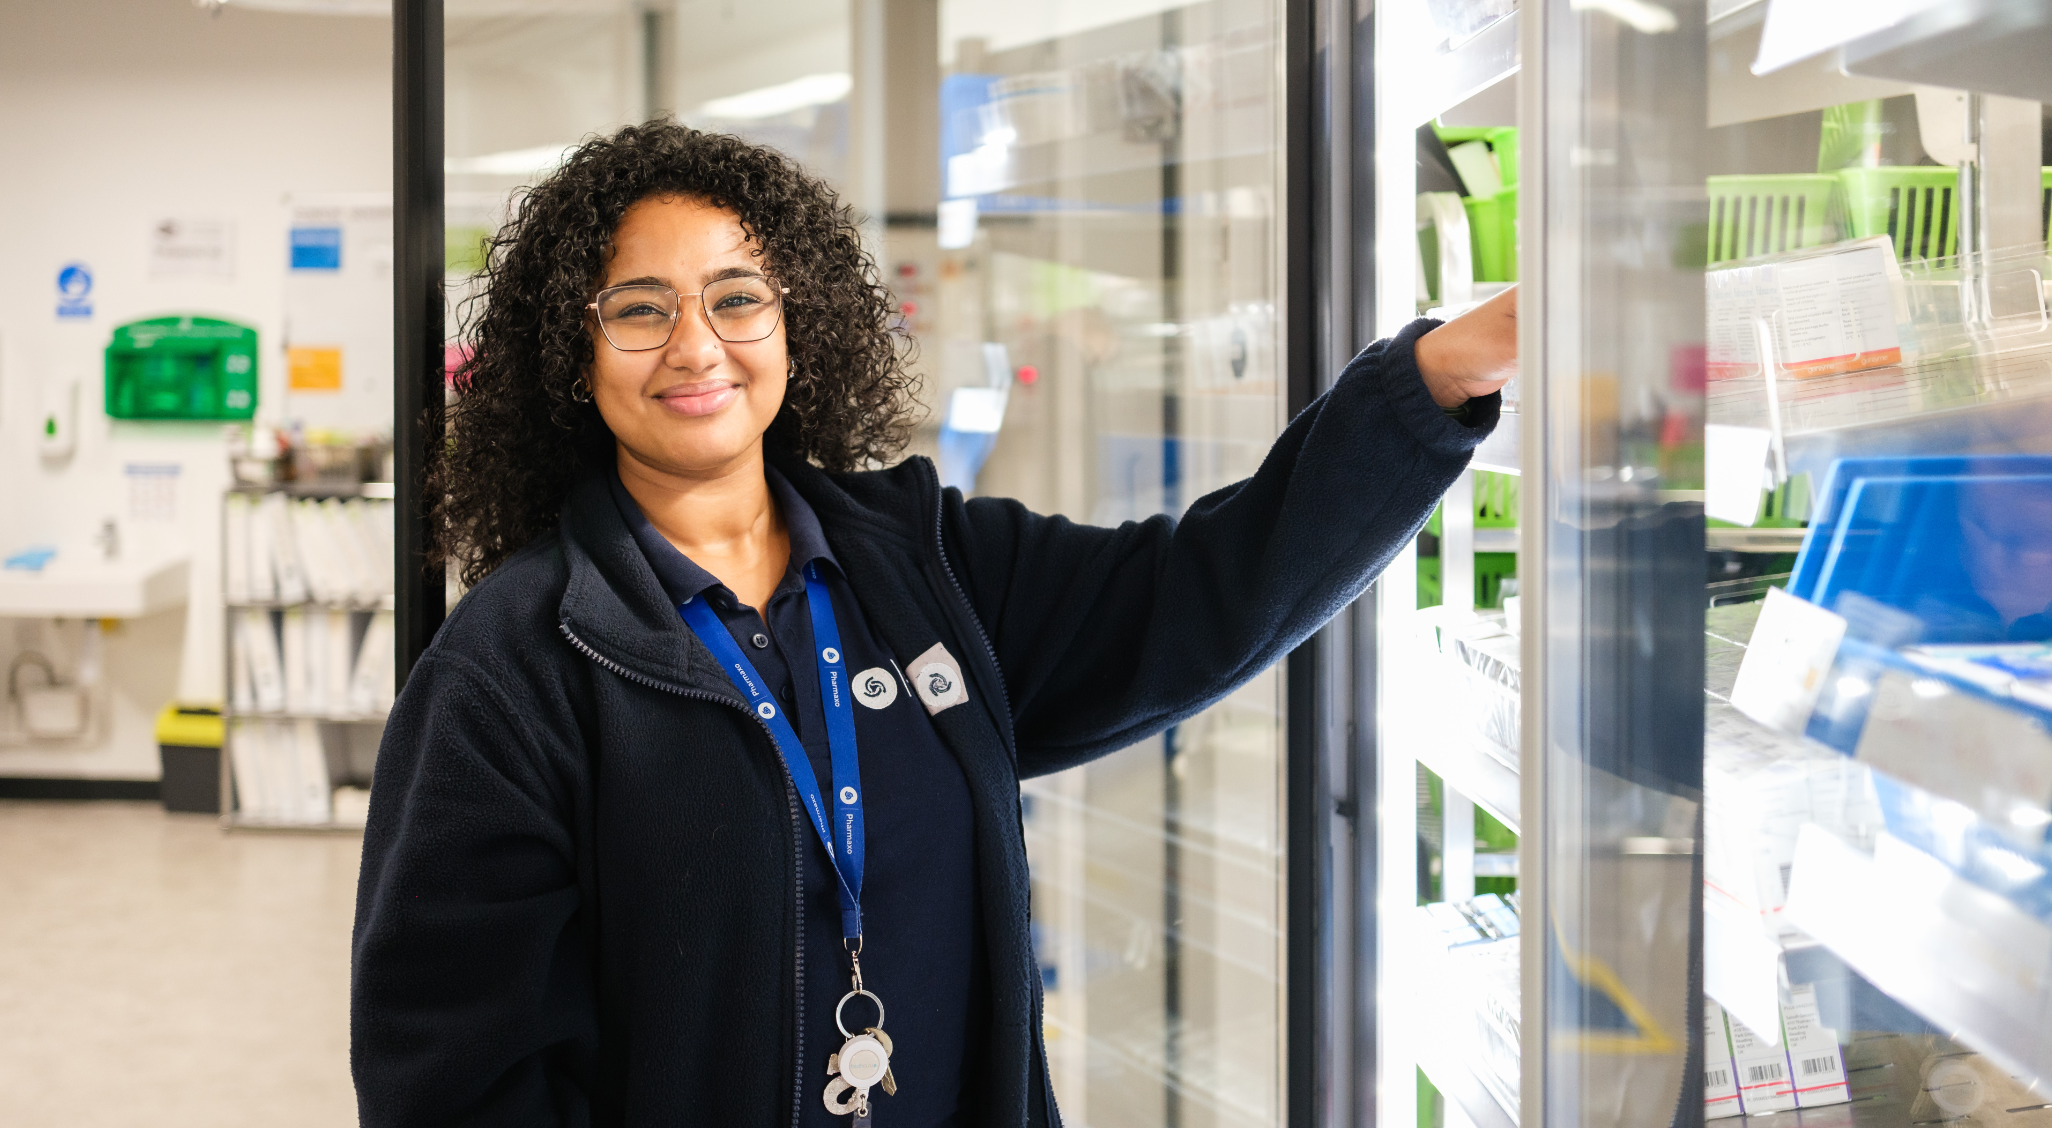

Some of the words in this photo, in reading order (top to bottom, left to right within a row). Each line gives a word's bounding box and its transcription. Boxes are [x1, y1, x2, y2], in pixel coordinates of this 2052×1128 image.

[1807, 363, 1835, 374] genzyme
[1860, 355, 1888, 365] genzyme
[734, 663, 760, 697] Pharmaxo
[830, 671, 840, 707] Pharmaxo
[810, 793, 826, 833] Pharmaxo
[846, 813, 854, 855] Pharmaxo
